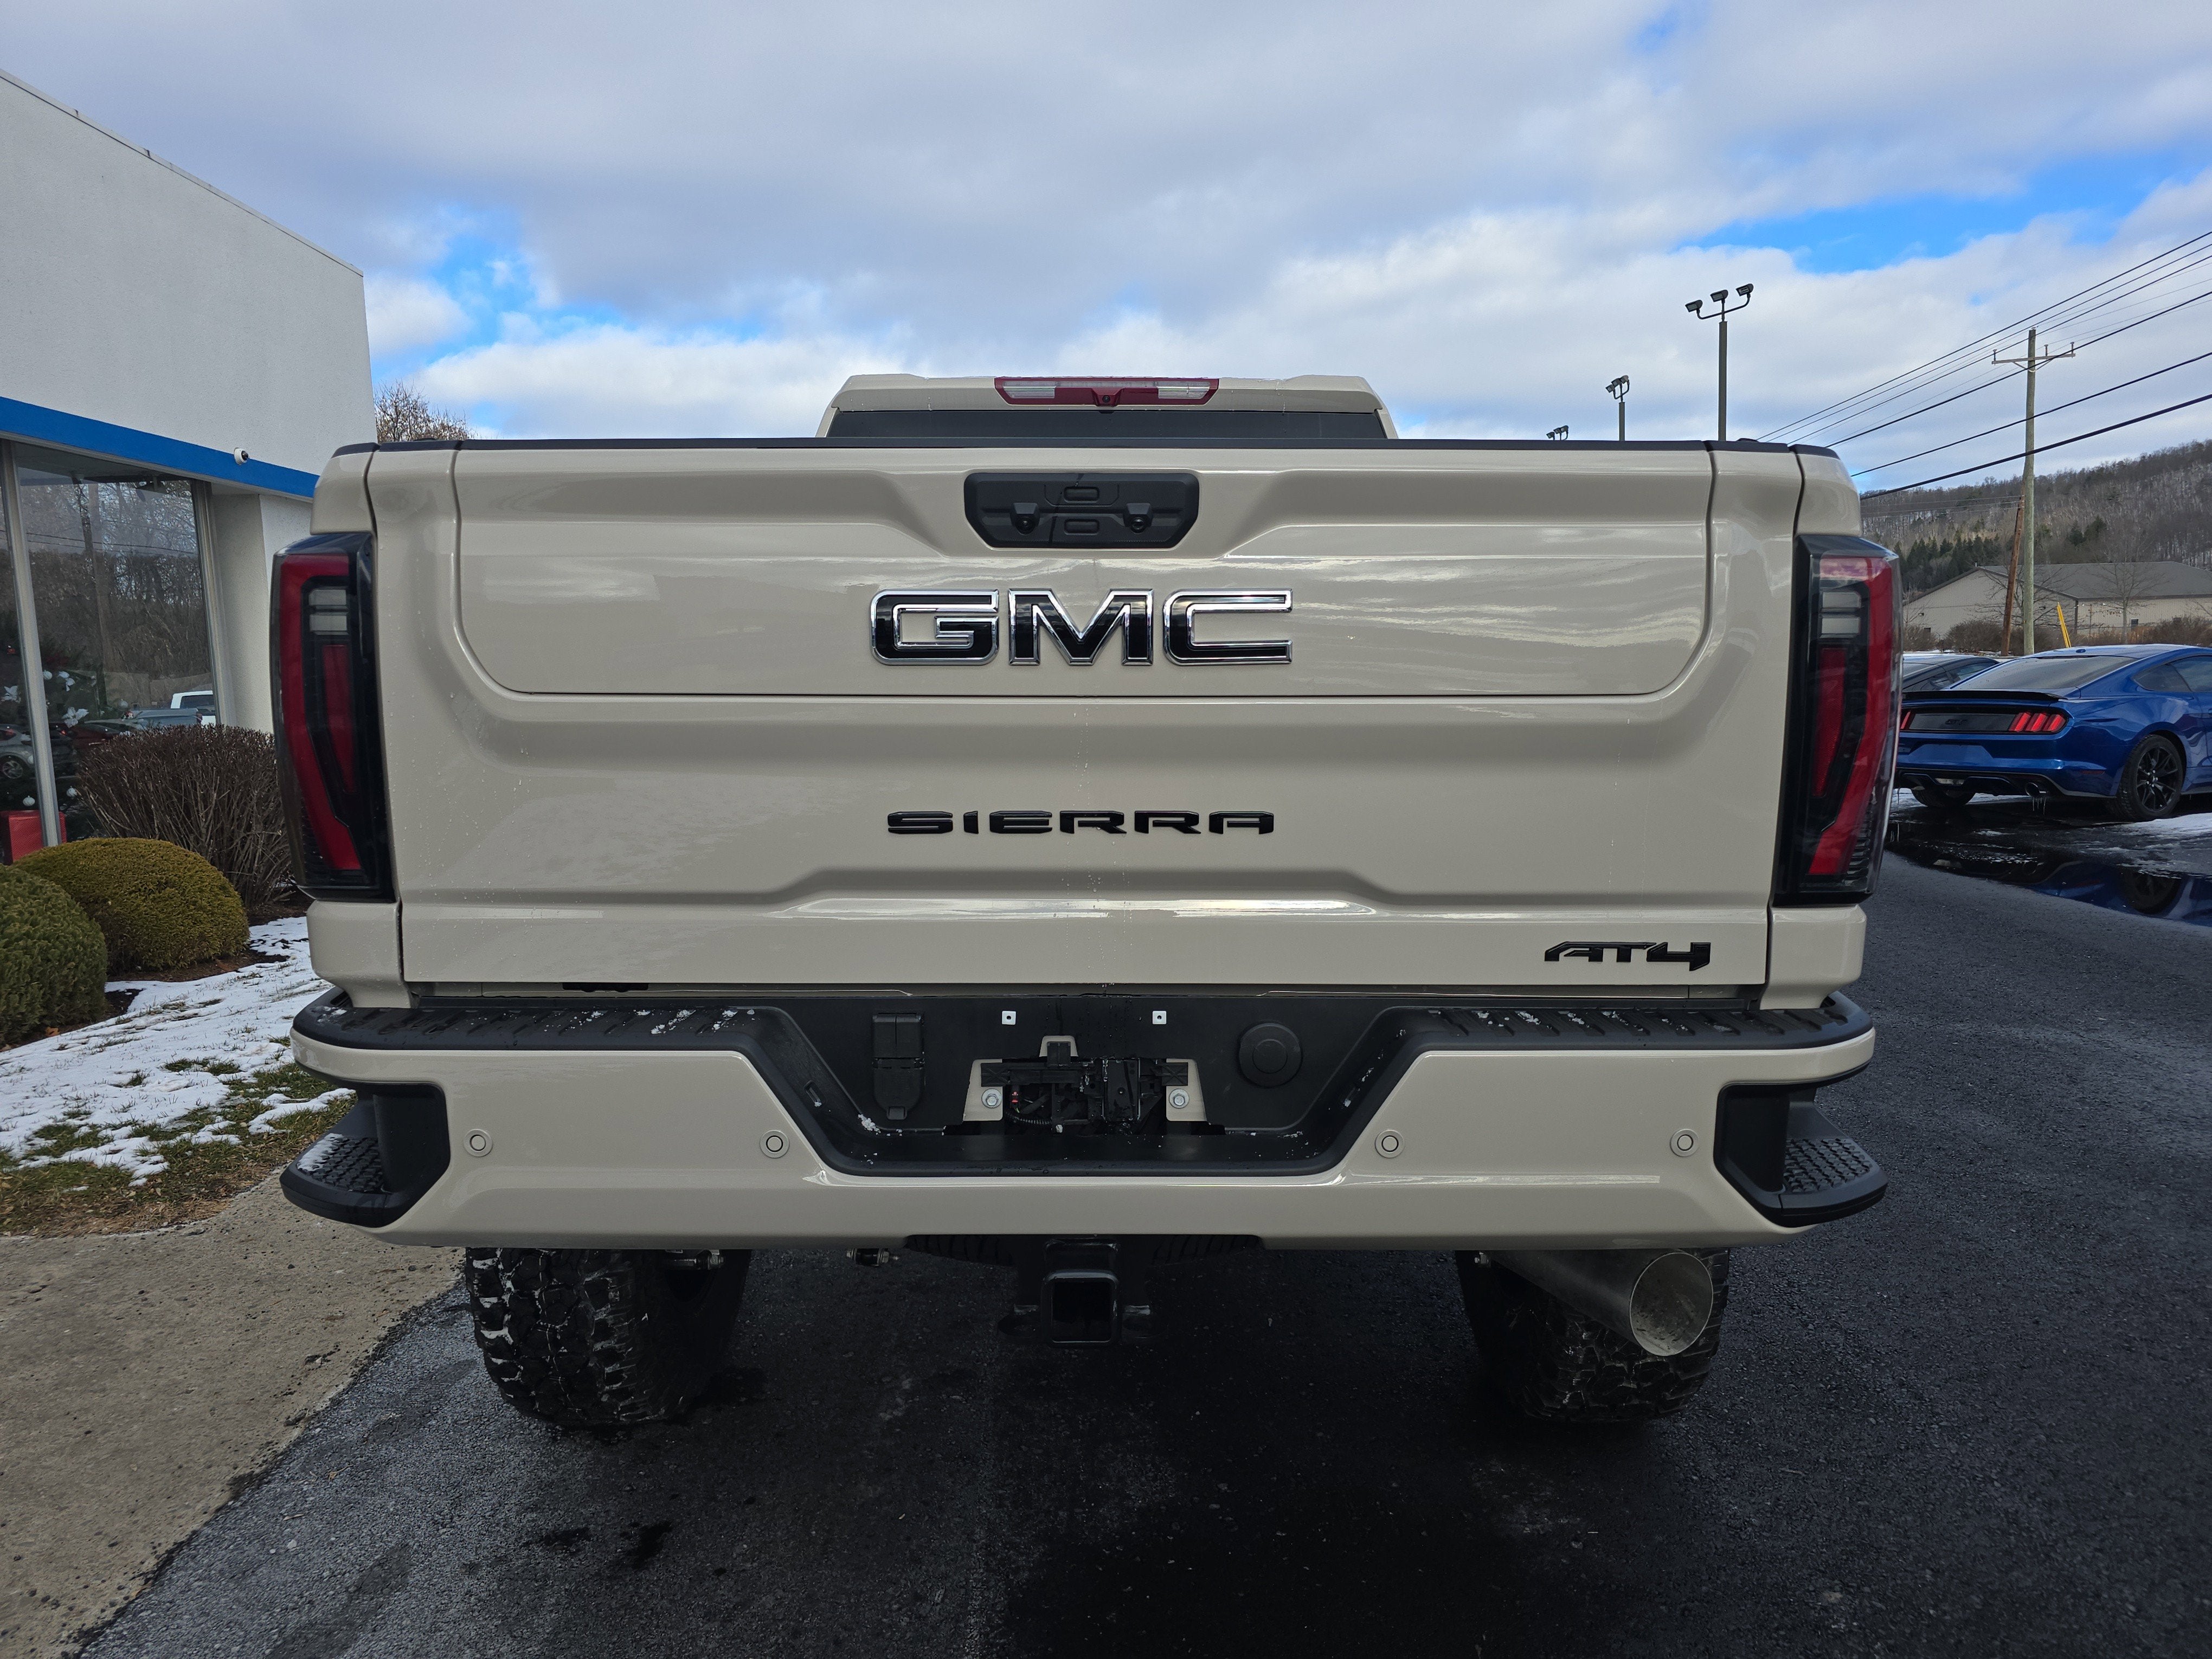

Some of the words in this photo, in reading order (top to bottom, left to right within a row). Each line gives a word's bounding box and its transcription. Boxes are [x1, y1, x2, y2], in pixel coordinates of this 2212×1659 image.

[870, 588, 1293, 666] GMC
[887, 810, 1274, 835] SIERRA
[1544, 941, 1711, 972] AT4
